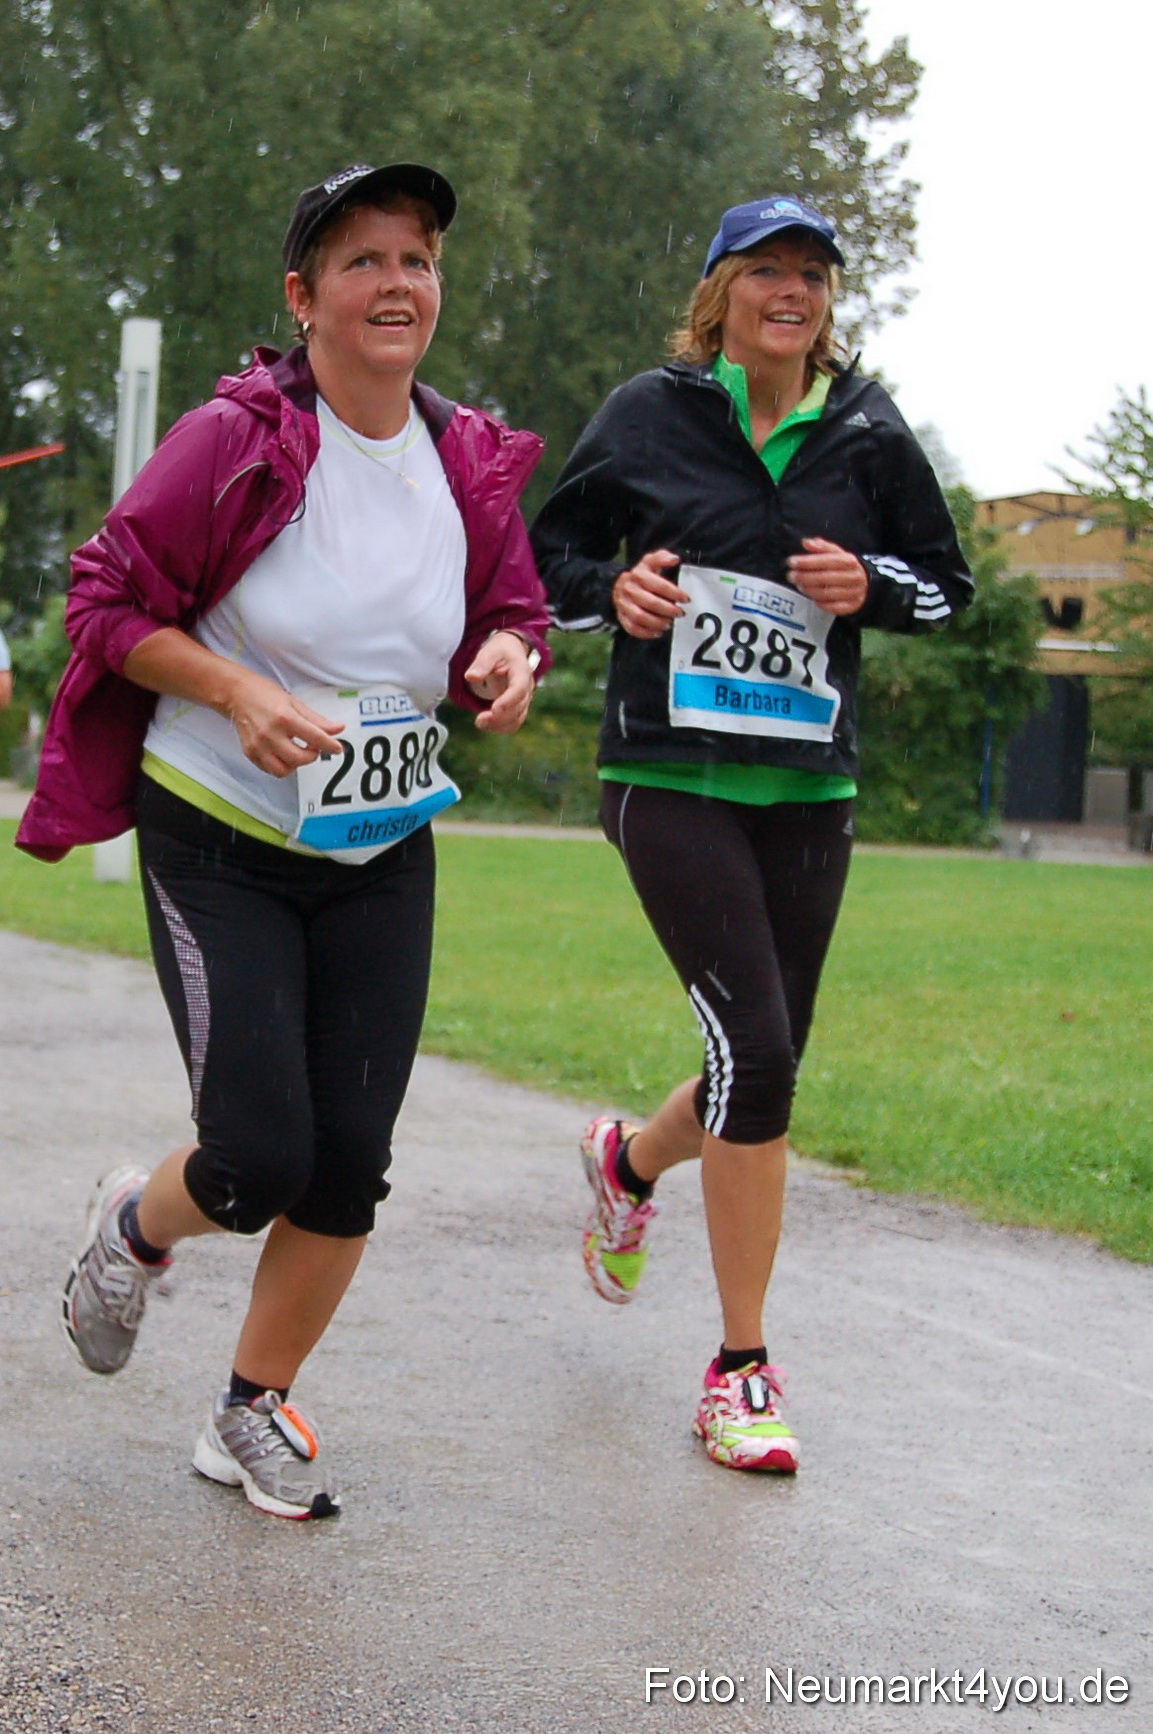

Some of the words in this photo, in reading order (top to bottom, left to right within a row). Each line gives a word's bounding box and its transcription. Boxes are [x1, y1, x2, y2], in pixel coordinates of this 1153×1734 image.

[691, 612, 817, 688] 2887
[714, 684, 792, 715] Barbara
[320, 726, 438, 807] 2888
